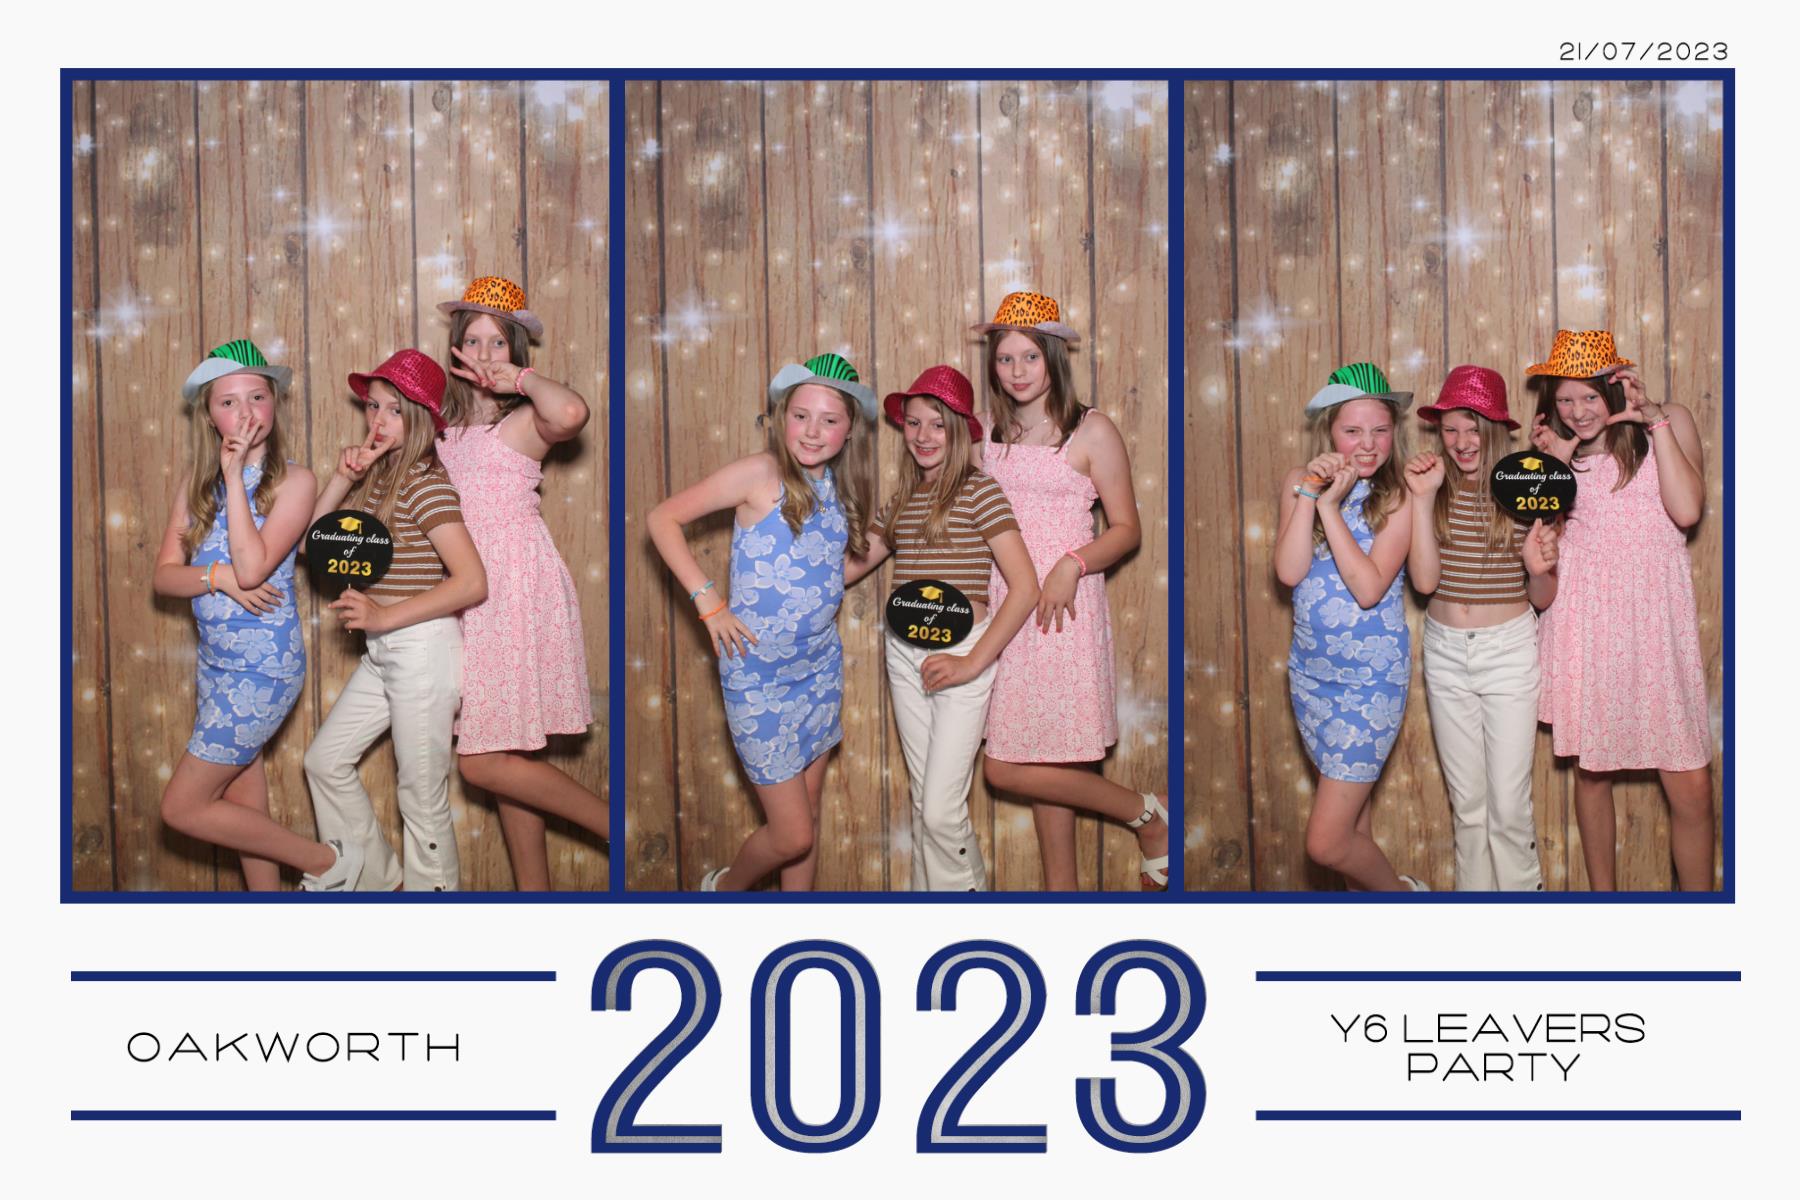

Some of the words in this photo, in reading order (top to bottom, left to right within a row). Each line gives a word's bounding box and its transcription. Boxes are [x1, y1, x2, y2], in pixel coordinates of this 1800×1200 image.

[1495, 470, 1547, 483] Graduating
[1549, 470, 1572, 481] class
[1529, 483, 1541, 495] of
[1516, 496, 1560, 510] 2023
[311, 529, 364, 546] Graduating
[365, 533, 390, 545] class
[343, 546, 357, 558] of
[327, 558, 372, 577] 2023
[892, 596, 945, 613] Graduating
[946, 602, 970, 614] class
[923, 613, 937, 625] of
[907, 624, 952, 643] 2023
